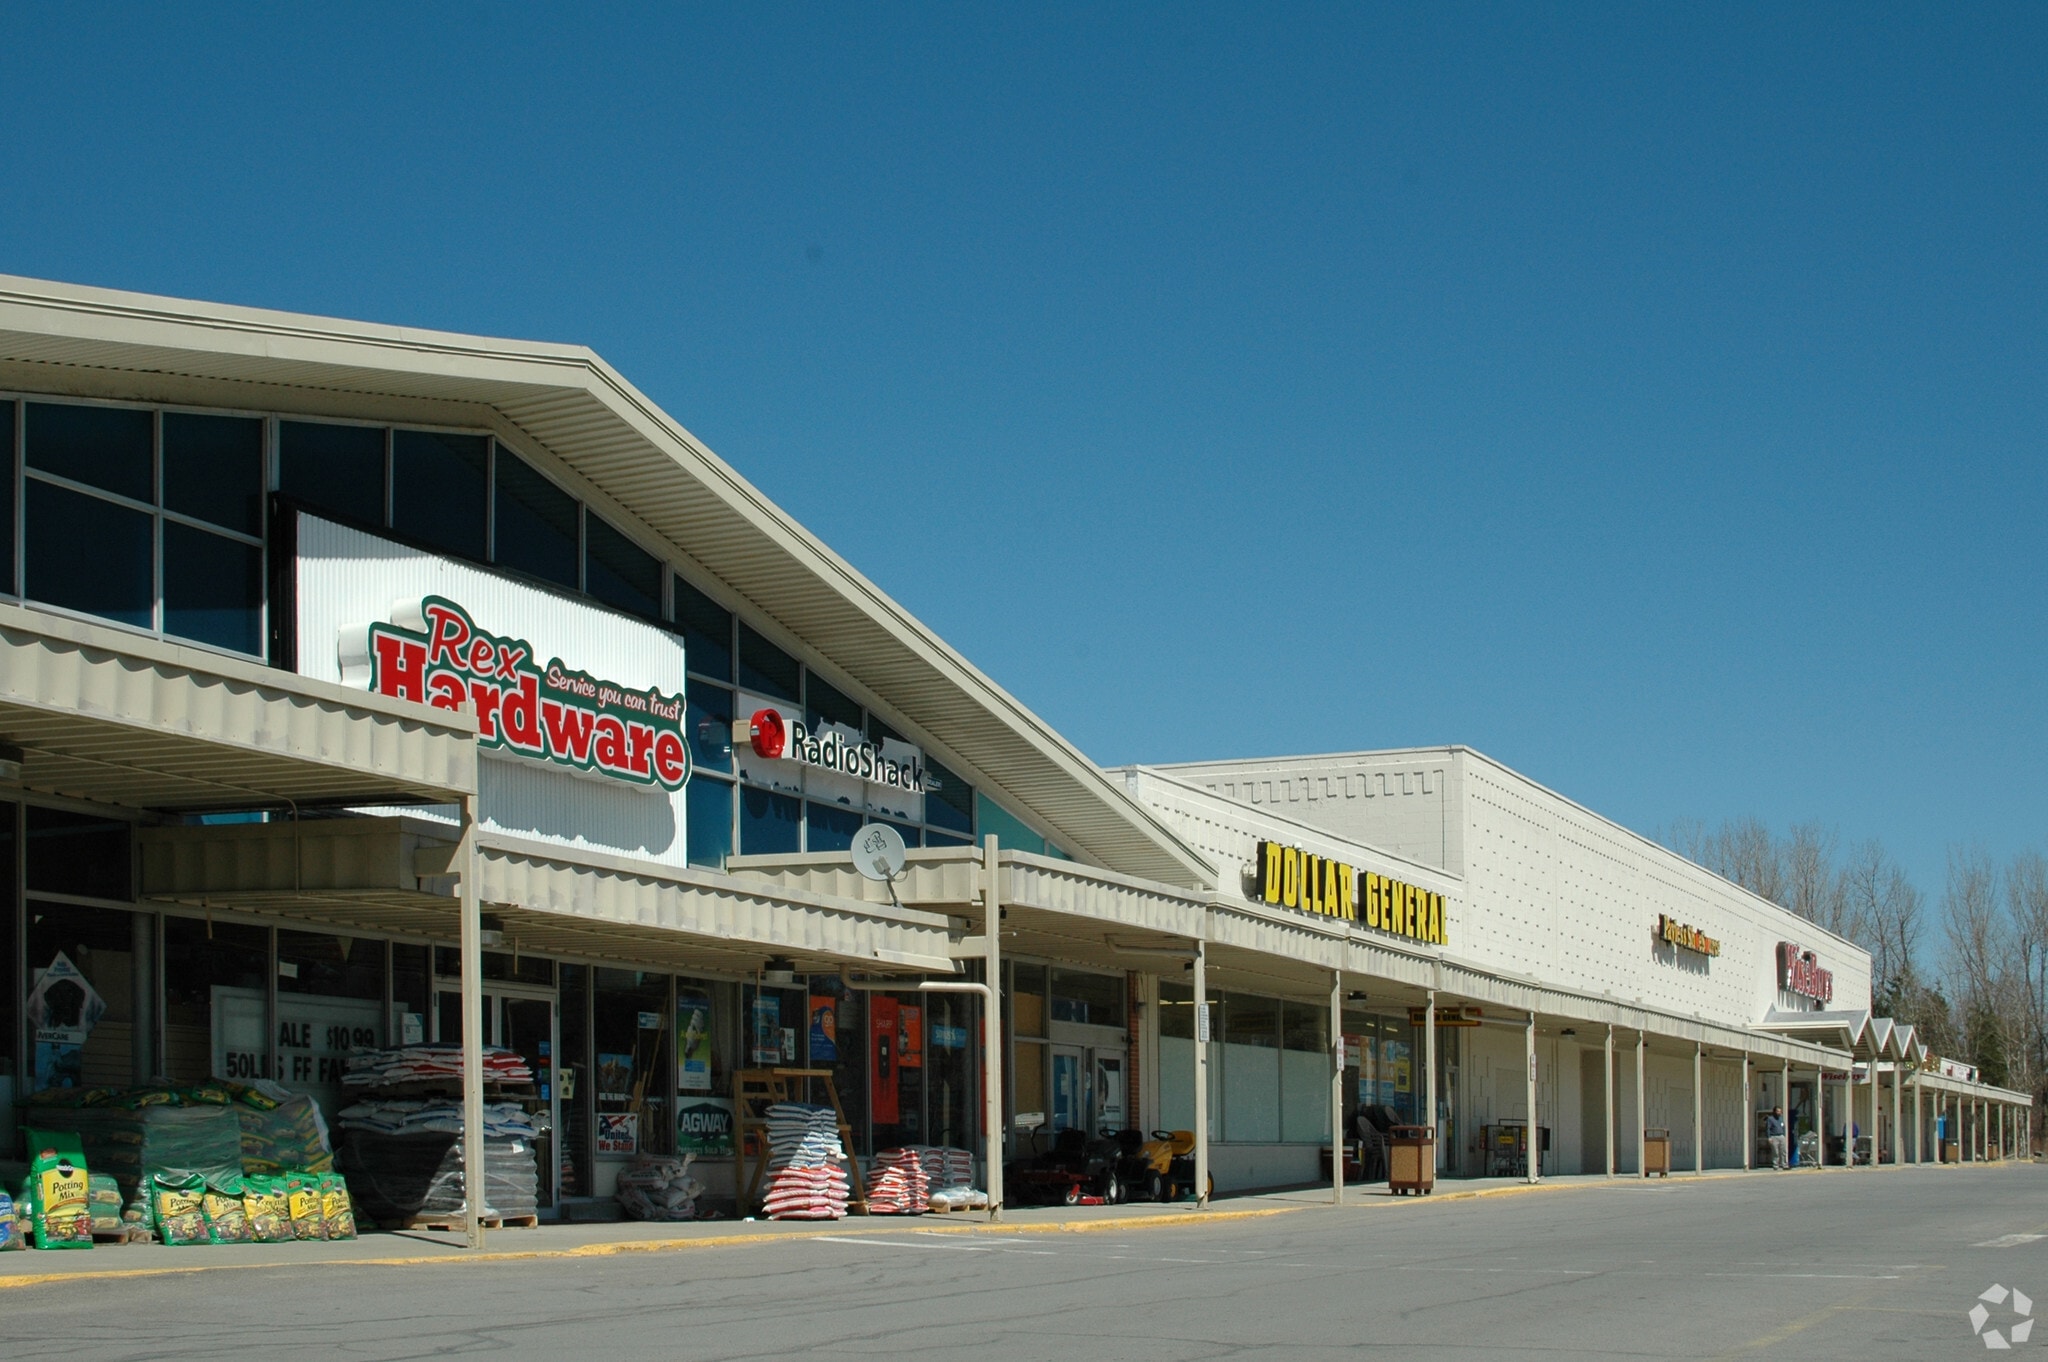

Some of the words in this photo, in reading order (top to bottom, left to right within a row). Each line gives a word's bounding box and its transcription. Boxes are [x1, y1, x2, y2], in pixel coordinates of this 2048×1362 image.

[425, 604, 528, 682] Rex
[373, 630, 686, 783] Hardware
[547, 666, 597, 699] Service
[599, 687, 622, 709] you
[624, 691, 648, 712] can
[650, 696, 682, 721] trust
[791, 721, 925, 793] RadioShack
[1262, 841, 1355, 921] DOLLAR
[1364, 871, 1448, 946] GENERAL
[599, 1141, 610, 1151] We
[613, 1140, 634, 1151] Stand
[681, 1113, 730, 1133] AGWAY
[53, 1181, 84, 1194] Potting
[60, 1191, 75, 1201] Mix
